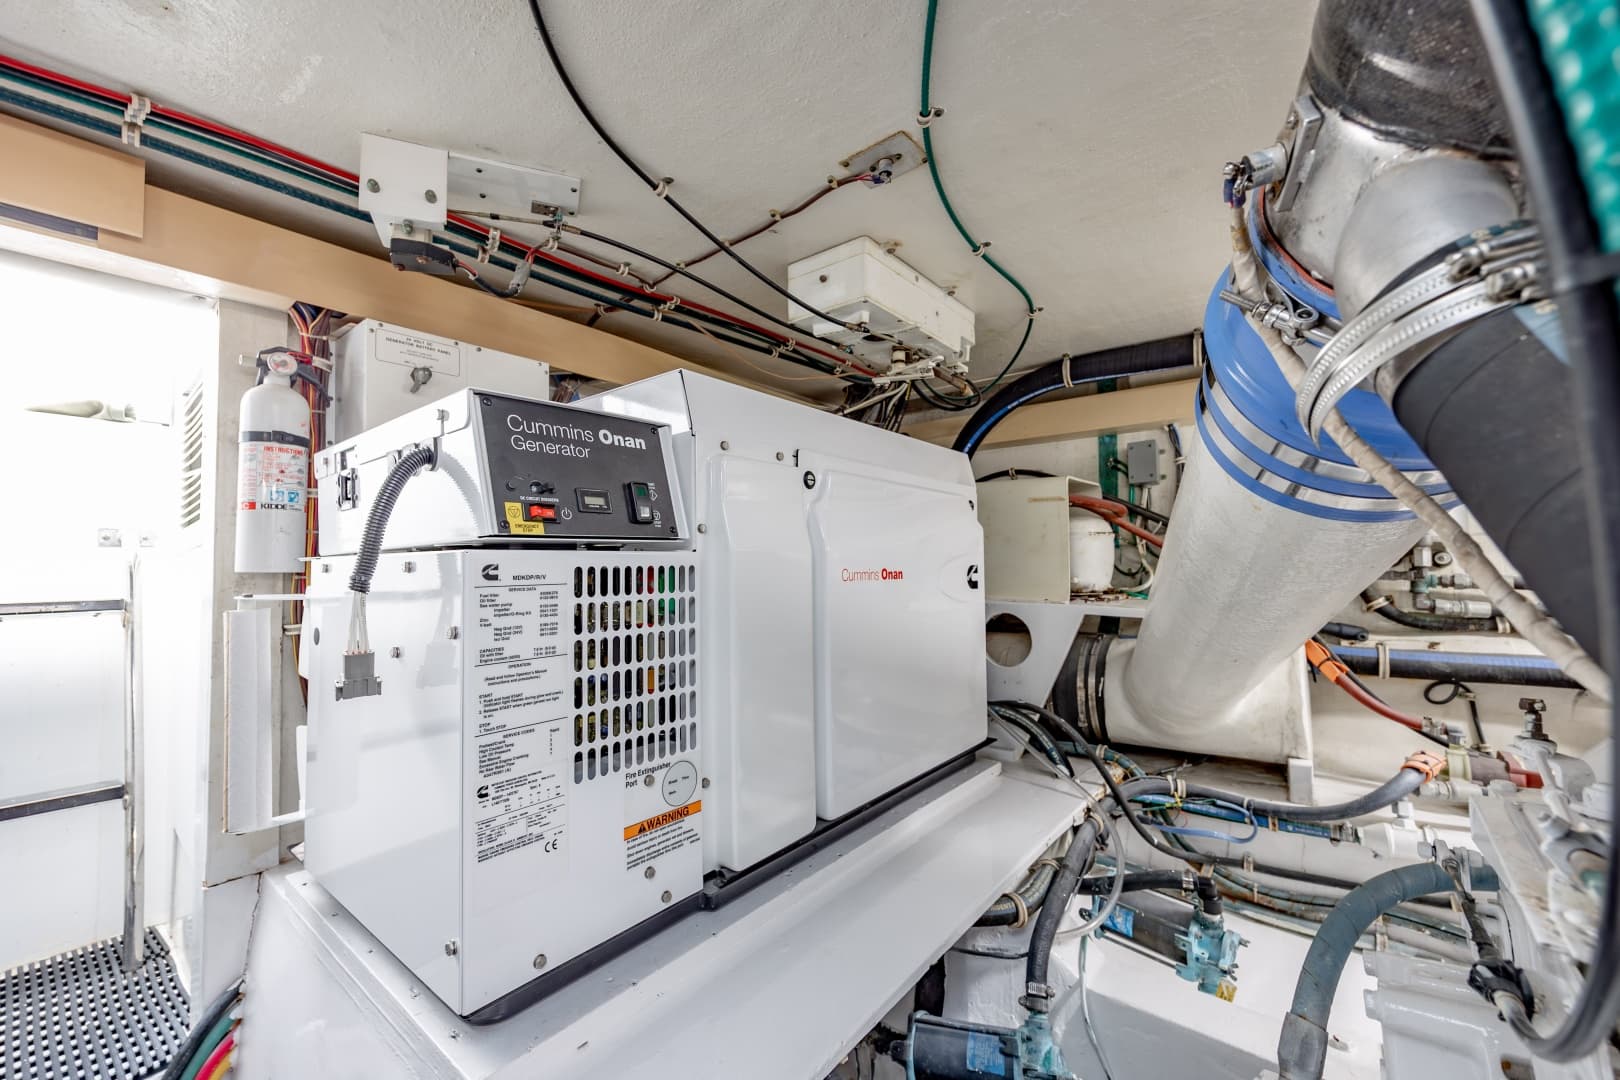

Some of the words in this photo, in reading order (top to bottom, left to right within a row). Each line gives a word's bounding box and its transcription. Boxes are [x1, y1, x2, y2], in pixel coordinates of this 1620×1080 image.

[506, 414, 594, 443] Cummins
[599, 430, 647, 450] Onan
[264, 446, 303, 455] INSTRUCTIONS
[510, 435, 590, 459] Generator
[841, 568, 880, 581] Cummins
[881, 568, 903, 580] Onan
[626, 772, 637, 780] Fire
[638, 762, 671, 776] Extinguisher
[626, 780, 638, 789] Port
[647, 806, 690, 829] WARNING
